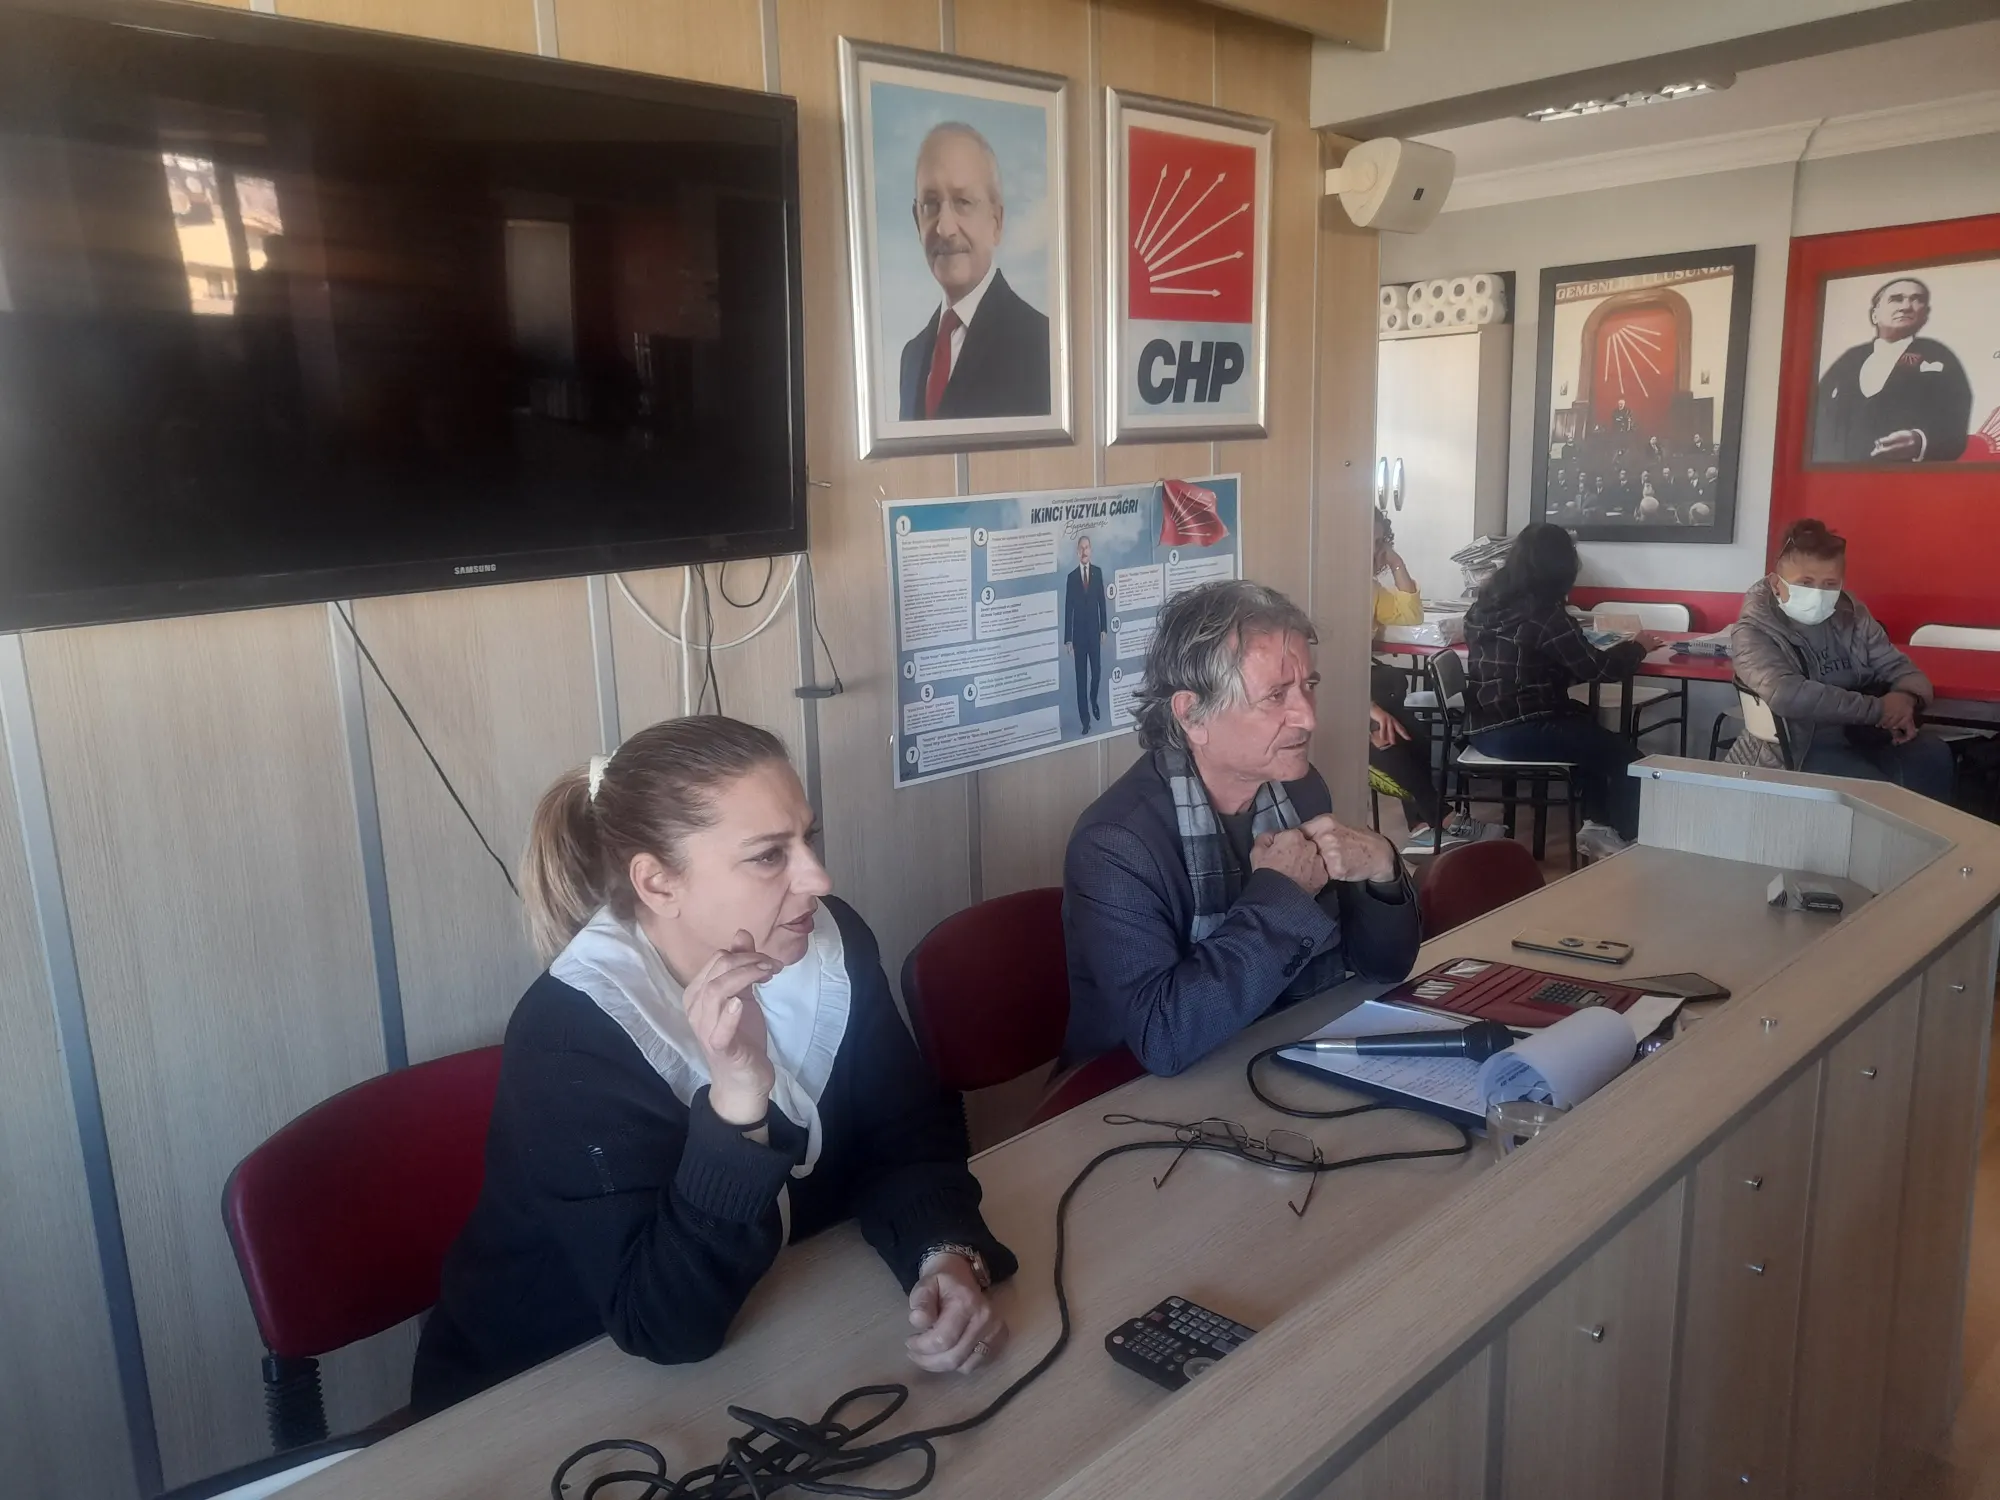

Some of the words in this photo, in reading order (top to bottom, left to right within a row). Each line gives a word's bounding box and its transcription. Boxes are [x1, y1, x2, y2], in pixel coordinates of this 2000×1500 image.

[1137, 338, 1245, 405] CHP
[1065, 501, 1107, 521] YÜZYILA
[1109, 498, 1139, 517] ÇAĞRI
[978, 531, 984, 542] 2
[1172, 552, 1177, 561] 9
[454, 564, 497, 575] SAMSUNG
[985, 590, 991, 601] 3
[1109, 586, 1114, 596] 8
[1112, 620, 1120, 629] 10
[906, 665, 912, 675] 4
[1113, 670, 1121, 679] 12
[924, 687, 930, 698] 5
[967, 687, 973, 697] 6
[909, 750, 915, 760] 7
